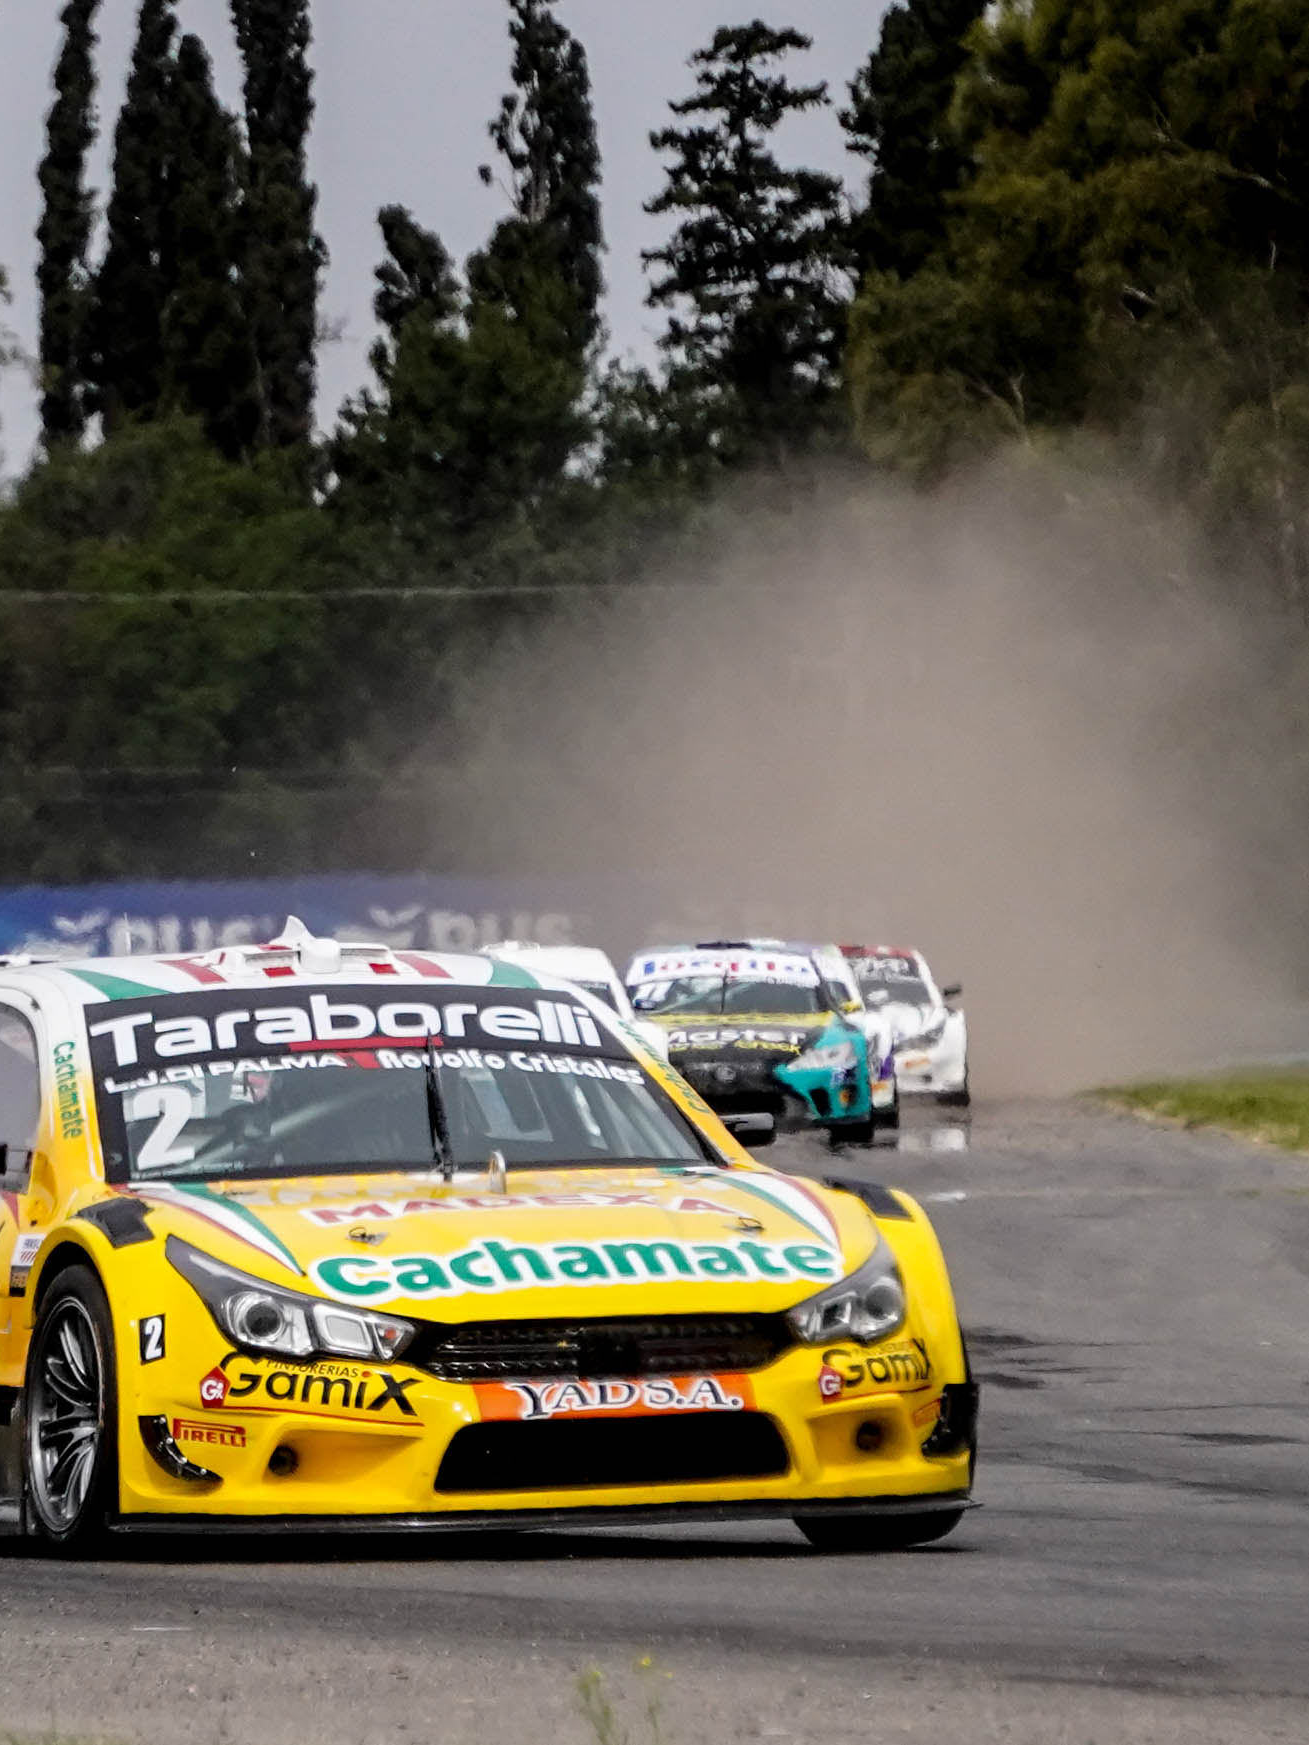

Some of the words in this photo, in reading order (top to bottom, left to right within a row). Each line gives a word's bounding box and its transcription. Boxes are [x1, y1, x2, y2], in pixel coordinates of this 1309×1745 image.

[89, 993, 602, 1068] Taraborelli
[208, 1052, 348, 1077] PALMA
[510, 1052, 645, 1085] Cristales
[53, 1040, 84, 1140] Cachamate
[133, 1084, 195, 1171] 2
[307, 1192, 740, 1226] MADEXA
[314, 1239, 838, 1298] Cachamate
[145, 1317, 163, 1360] 2
[173, 1418, 247, 1448] PIRELLI
